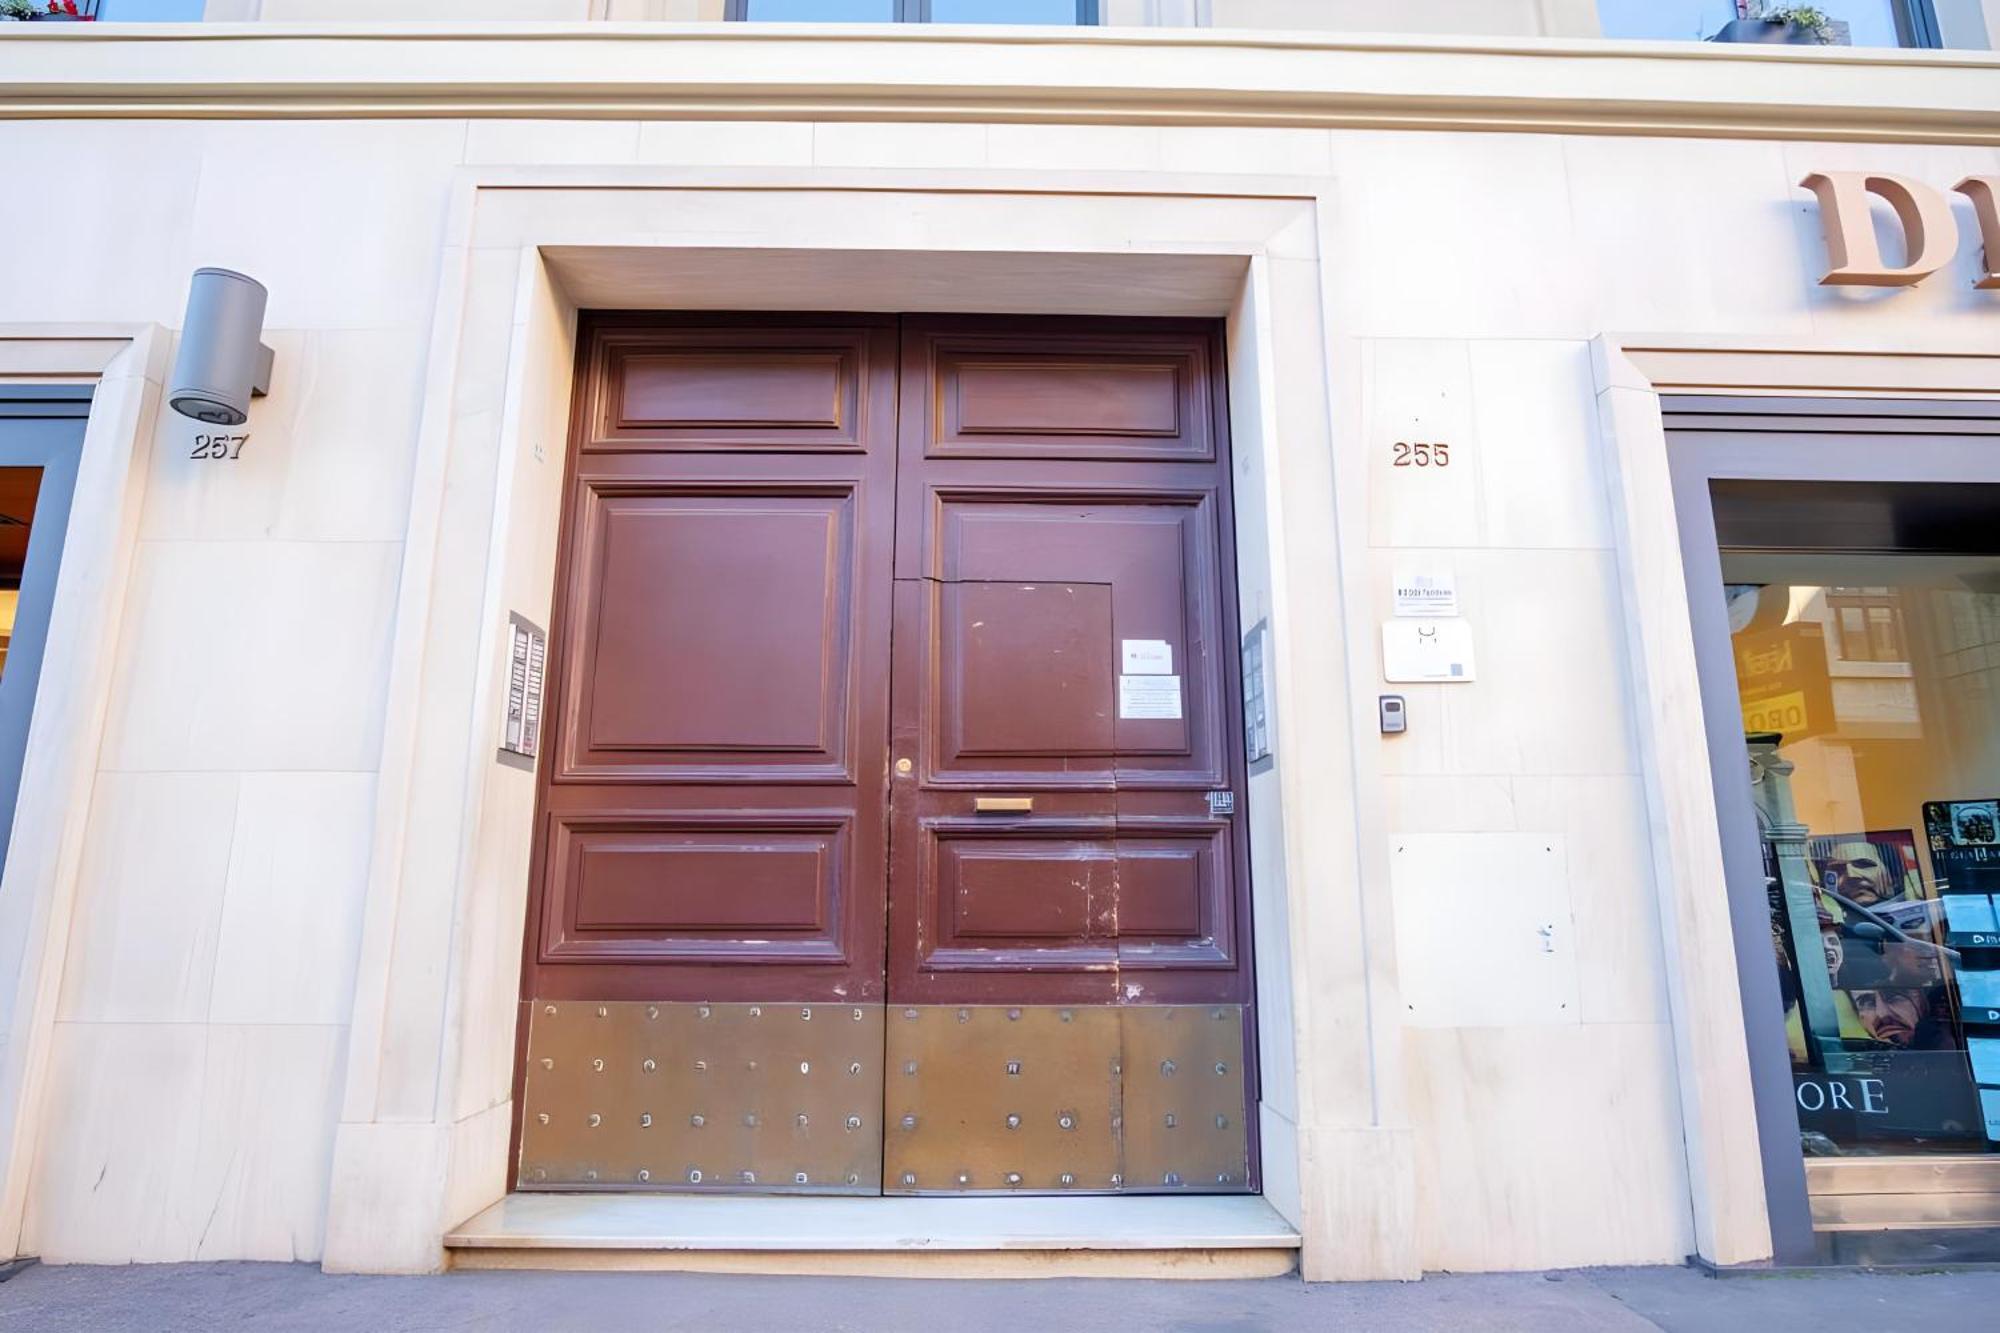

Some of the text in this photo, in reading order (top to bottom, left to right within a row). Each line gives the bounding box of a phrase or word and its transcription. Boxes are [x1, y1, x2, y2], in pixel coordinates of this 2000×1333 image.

[190, 434, 250, 459] 257
[1393, 442, 1448, 467] 255
[1797, 1079, 1889, 1113] ORE
